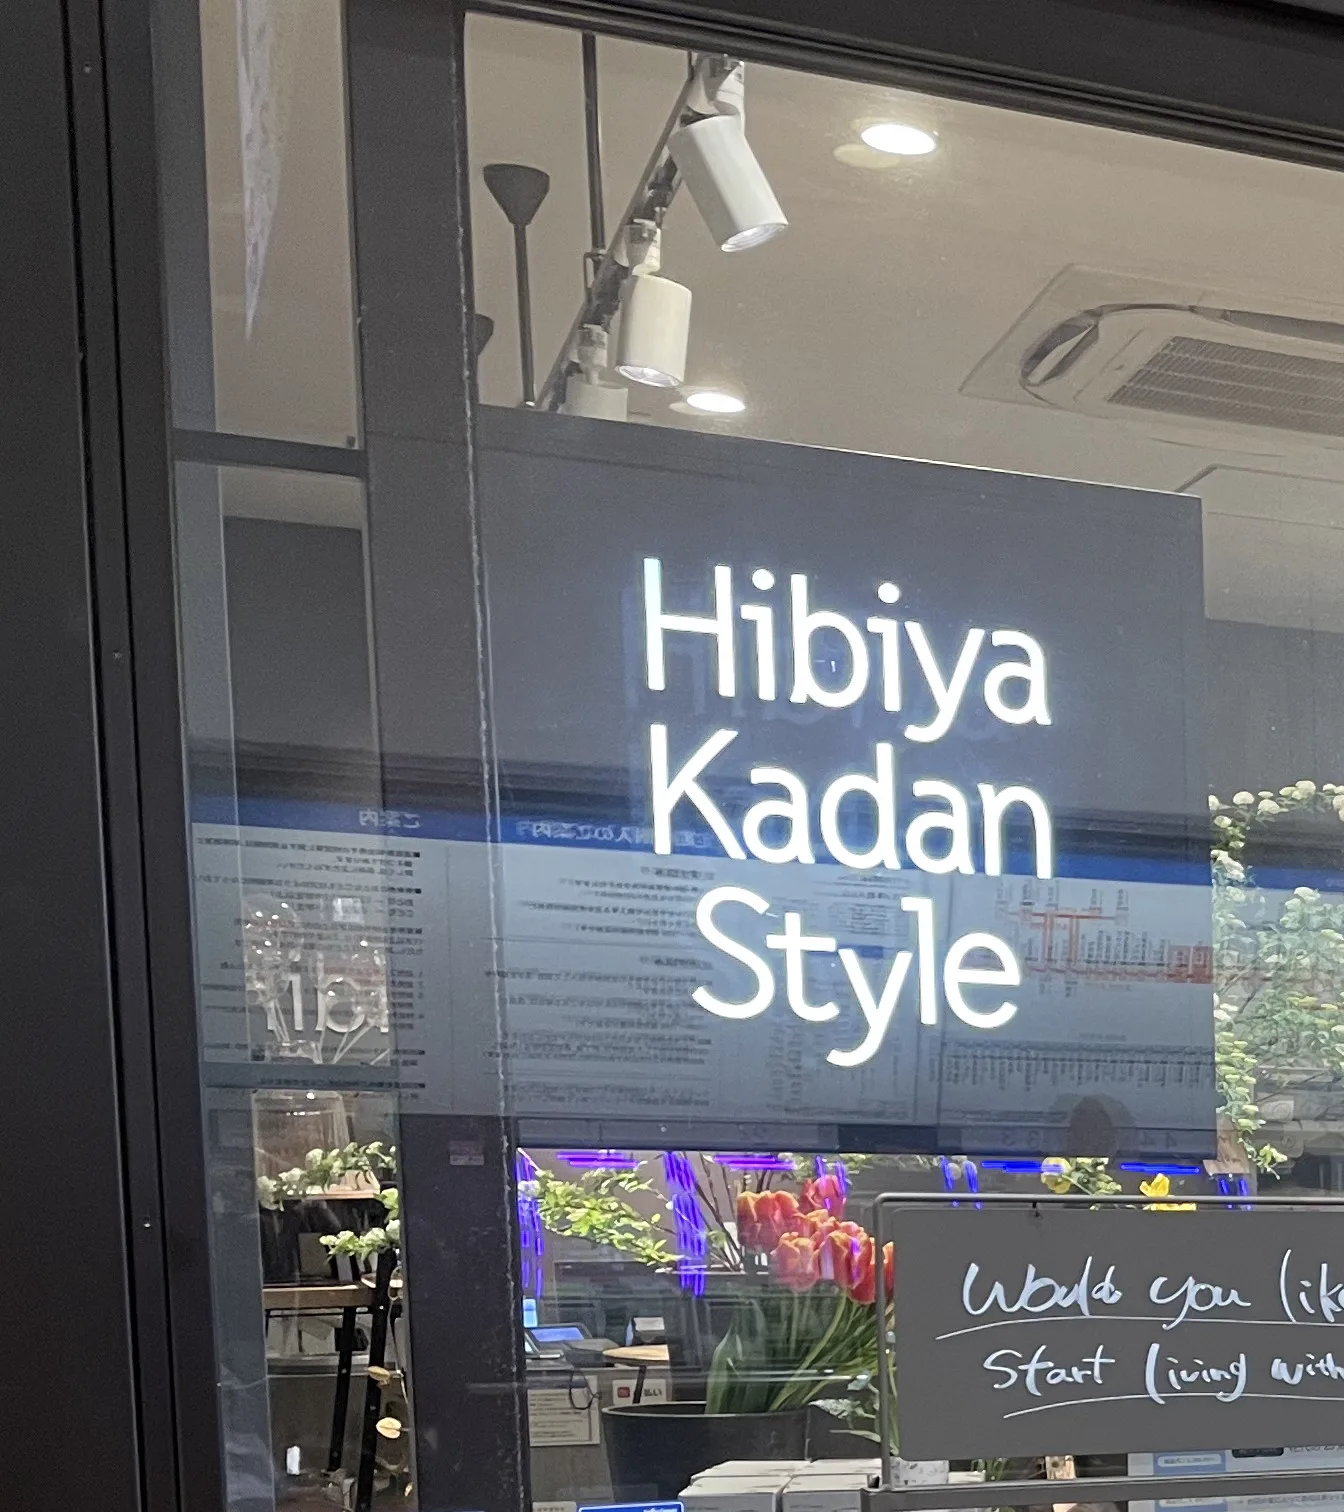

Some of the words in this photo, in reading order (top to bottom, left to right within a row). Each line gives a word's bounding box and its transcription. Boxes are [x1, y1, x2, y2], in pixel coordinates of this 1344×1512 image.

[643, 556, 1052, 743] Hibiya
[649, 723, 1053, 880] Kadan
[691, 885, 1021, 1067] Style
[961, 1255, 1123, 1318] Would
[1149, 1272, 1252, 1331] you
[1145, 1341, 1249, 1404] living
